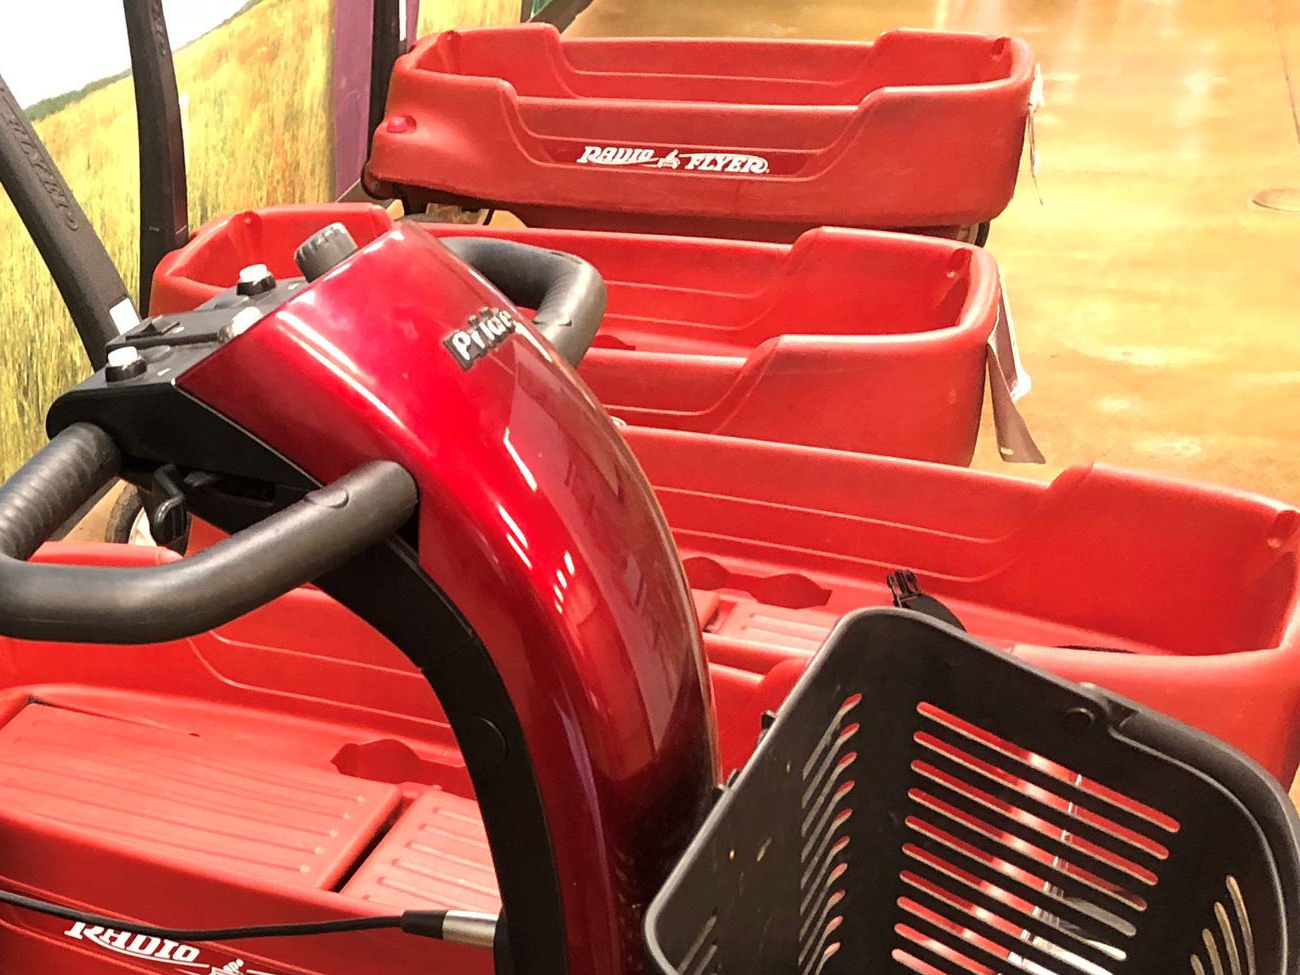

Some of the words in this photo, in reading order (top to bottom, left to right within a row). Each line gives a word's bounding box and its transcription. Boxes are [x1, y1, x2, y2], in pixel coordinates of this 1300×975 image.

[576, 145, 657, 166] RADIO
[684, 153, 769, 174] FLYER
[450, 306, 515, 362] Pride
